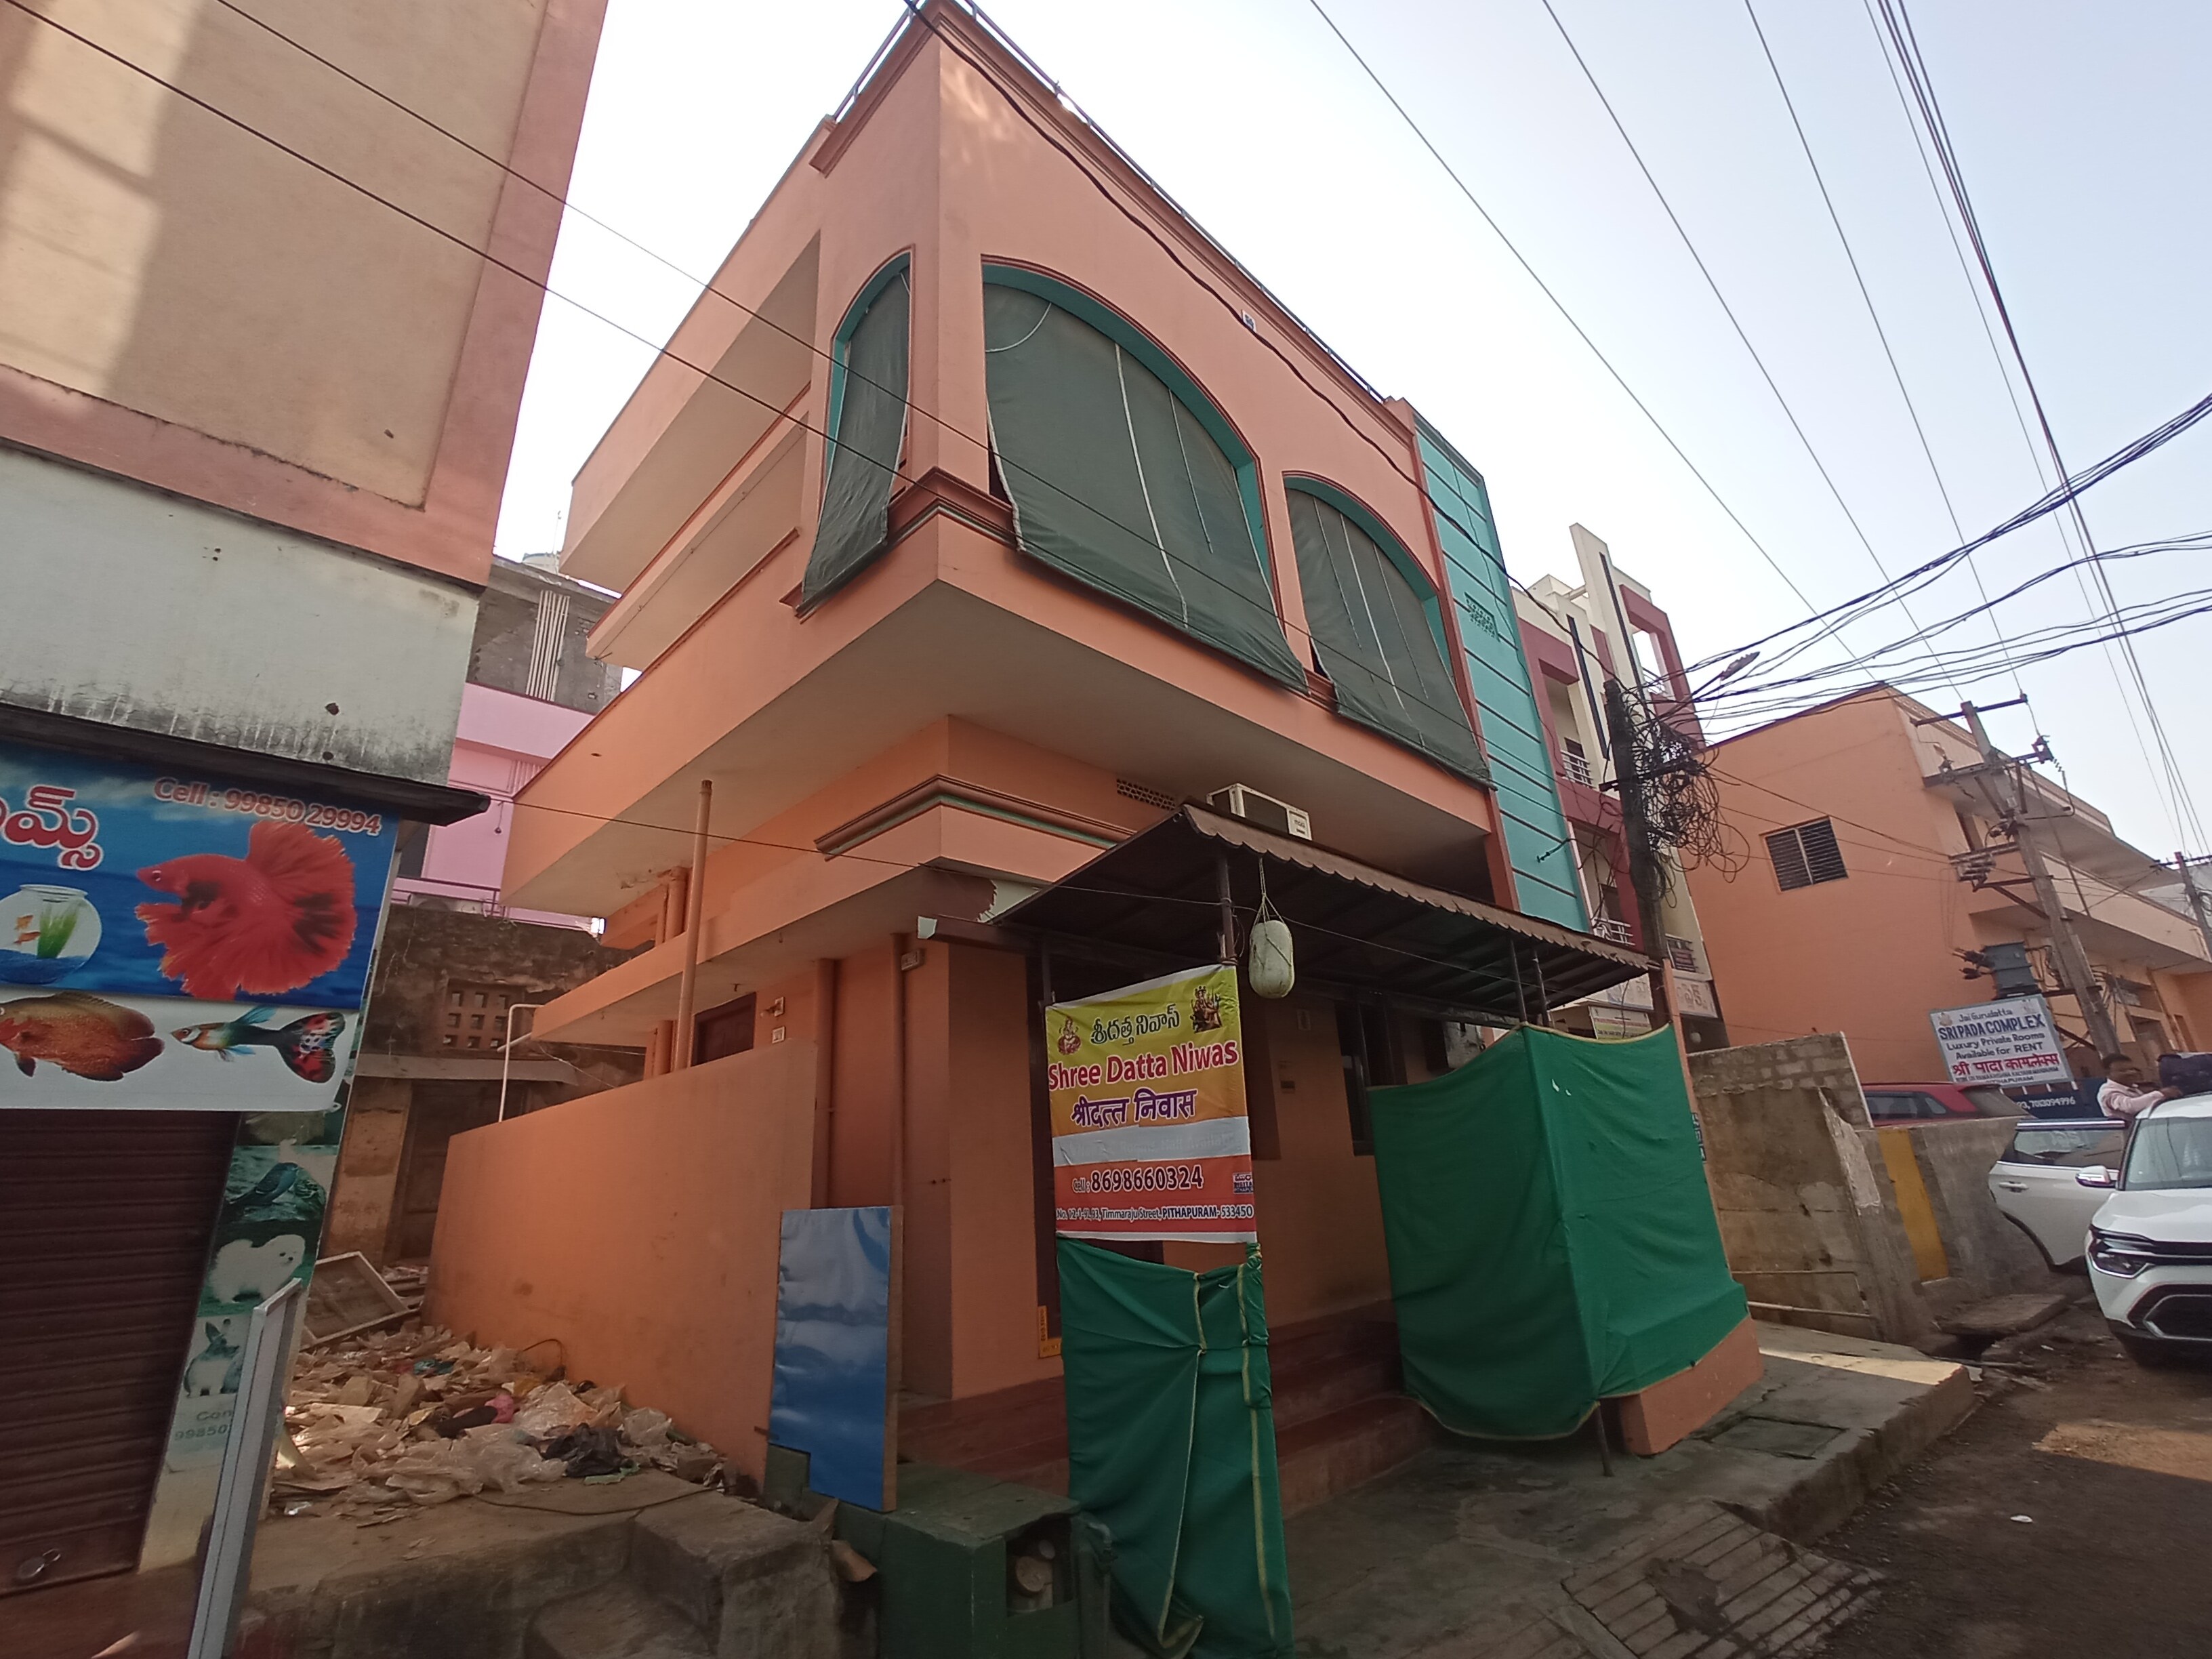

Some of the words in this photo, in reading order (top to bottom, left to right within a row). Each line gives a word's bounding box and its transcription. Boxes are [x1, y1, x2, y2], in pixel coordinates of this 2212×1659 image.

[154, 777, 207, 807] Cell
[224, 789, 306, 823] 99850
[306, 804, 382, 836] 29994
[1986, 1014, 2045, 1034] COMPLEX
[1946, 1041, 1979, 1051] Luxury
[1981, 1036, 2012, 1046] Private
[2013, 1032, 2045, 1042] Rooms
[1956, 1050, 1995, 1060] Available
[2014, 1042, 2043, 1053] RENT
[1049, 1061, 1101, 1091] Shree
[1106, 1053, 1167, 1084] Datta
[1171, 1041, 1238, 1075] Niwas
[1952, 1061, 1971, 1076] श्री
[1973, 1060, 2003, 1073] पादा
[1134, 1088, 1197, 1121] निवास
[1090, 1164, 1204, 1193] 8698660324
[1102, 1208, 1139, 1223] Timmaraju
[1221, 1204, 1254, 1218] 533450
